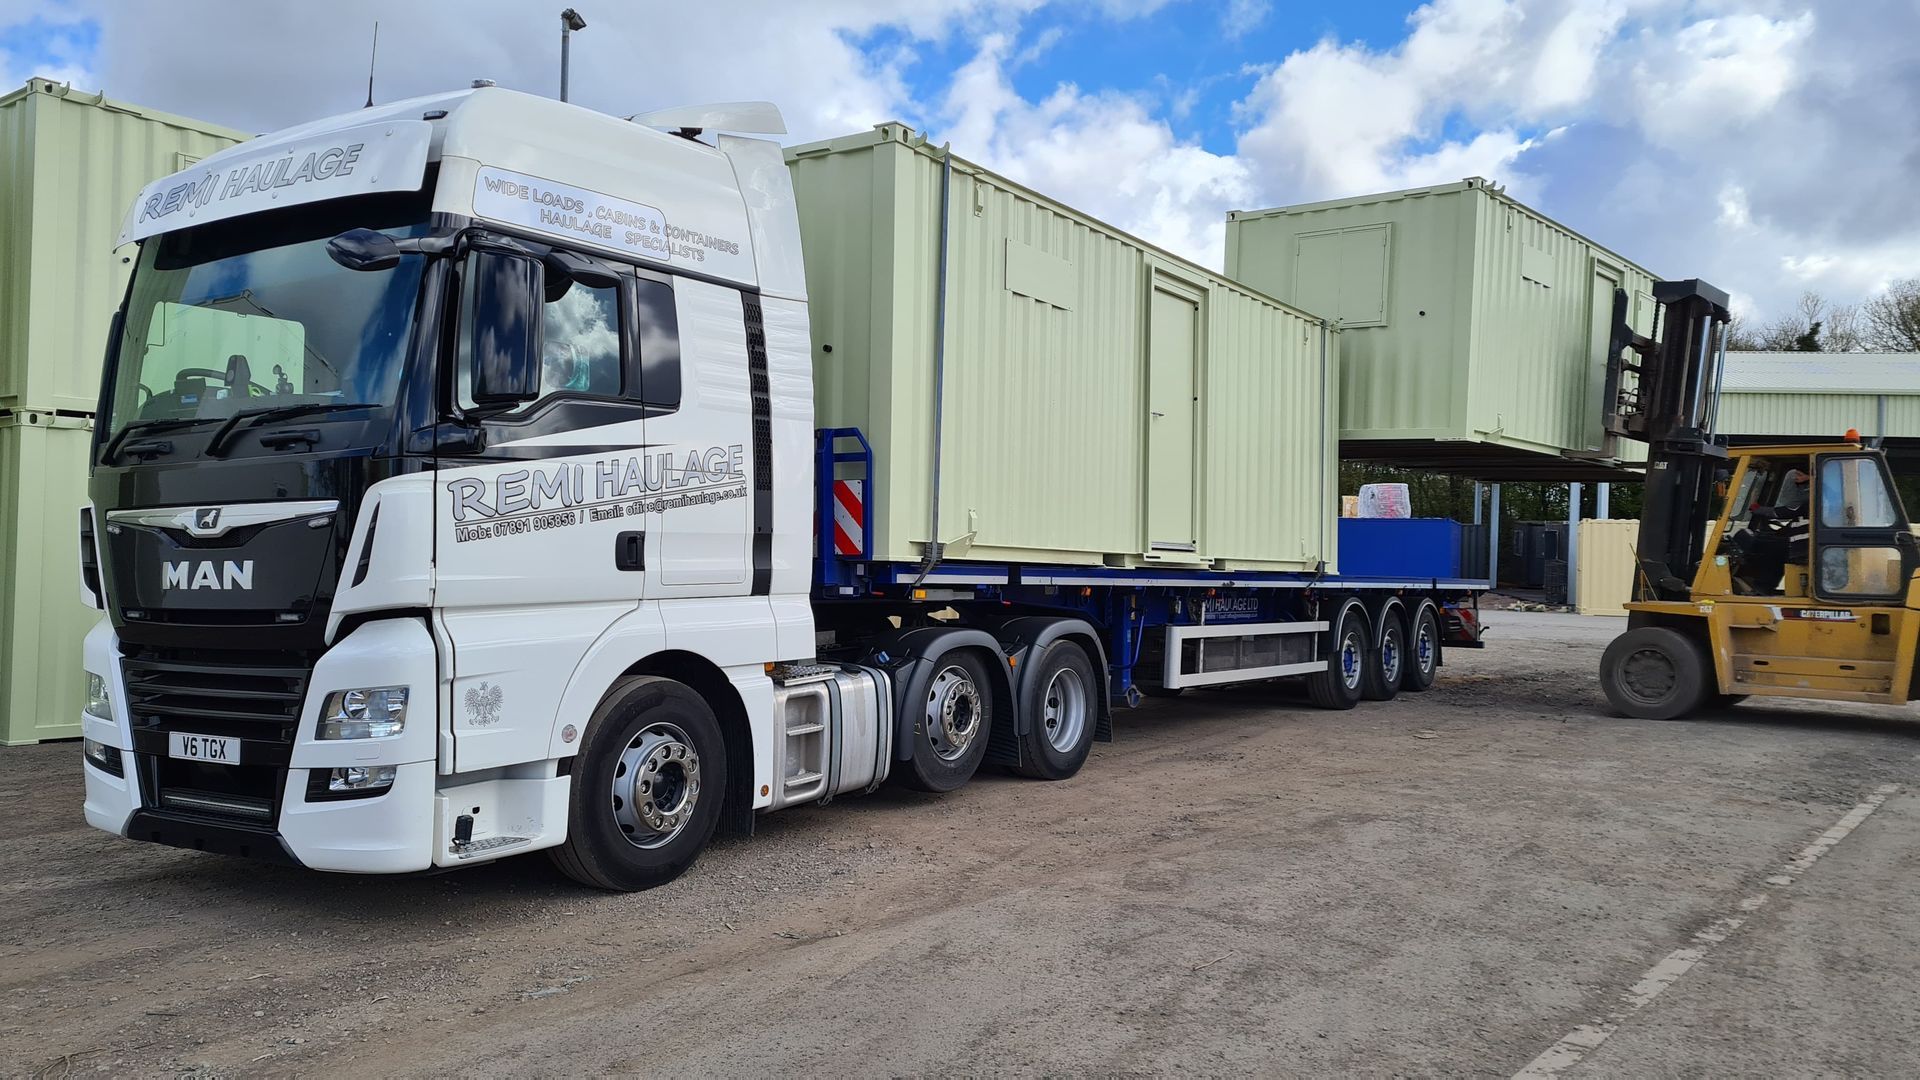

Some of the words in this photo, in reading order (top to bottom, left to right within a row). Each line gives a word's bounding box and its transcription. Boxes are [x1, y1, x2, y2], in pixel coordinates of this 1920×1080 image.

[139, 172, 220, 223] REMI
[220, 143, 364, 200] HAULAGE
[484, 175, 529, 200] WIDE
[532, 188, 584, 214] LOADS
[595, 206, 646, 231] CABINS
[649, 219, 660, 233] &
[663, 223, 739, 255] CONTAINERS
[539, 209, 612, 239] HAULAGE
[624, 231, 705, 262] SPECIALISTS
[447, 462, 584, 521] REMI
[596, 444, 743, 499] HAULAGE
[455, 525, 492, 543] Mob:
[492, 518, 531, 538] 07891
[533, 512, 576, 531] 905856
[589, 505, 624, 522] Email:
[625, 485, 748, 516] office@remihaulage.co.uk
[162, 560, 254, 590] MAN
[1215, 598, 1247, 612] HAULAGE
[1247, 598, 1259, 610] LTD
[1801, 609, 1851, 619] CATERPILLAR
[183, 736, 198, 756] V6
[201, 738, 227, 760] TGX
